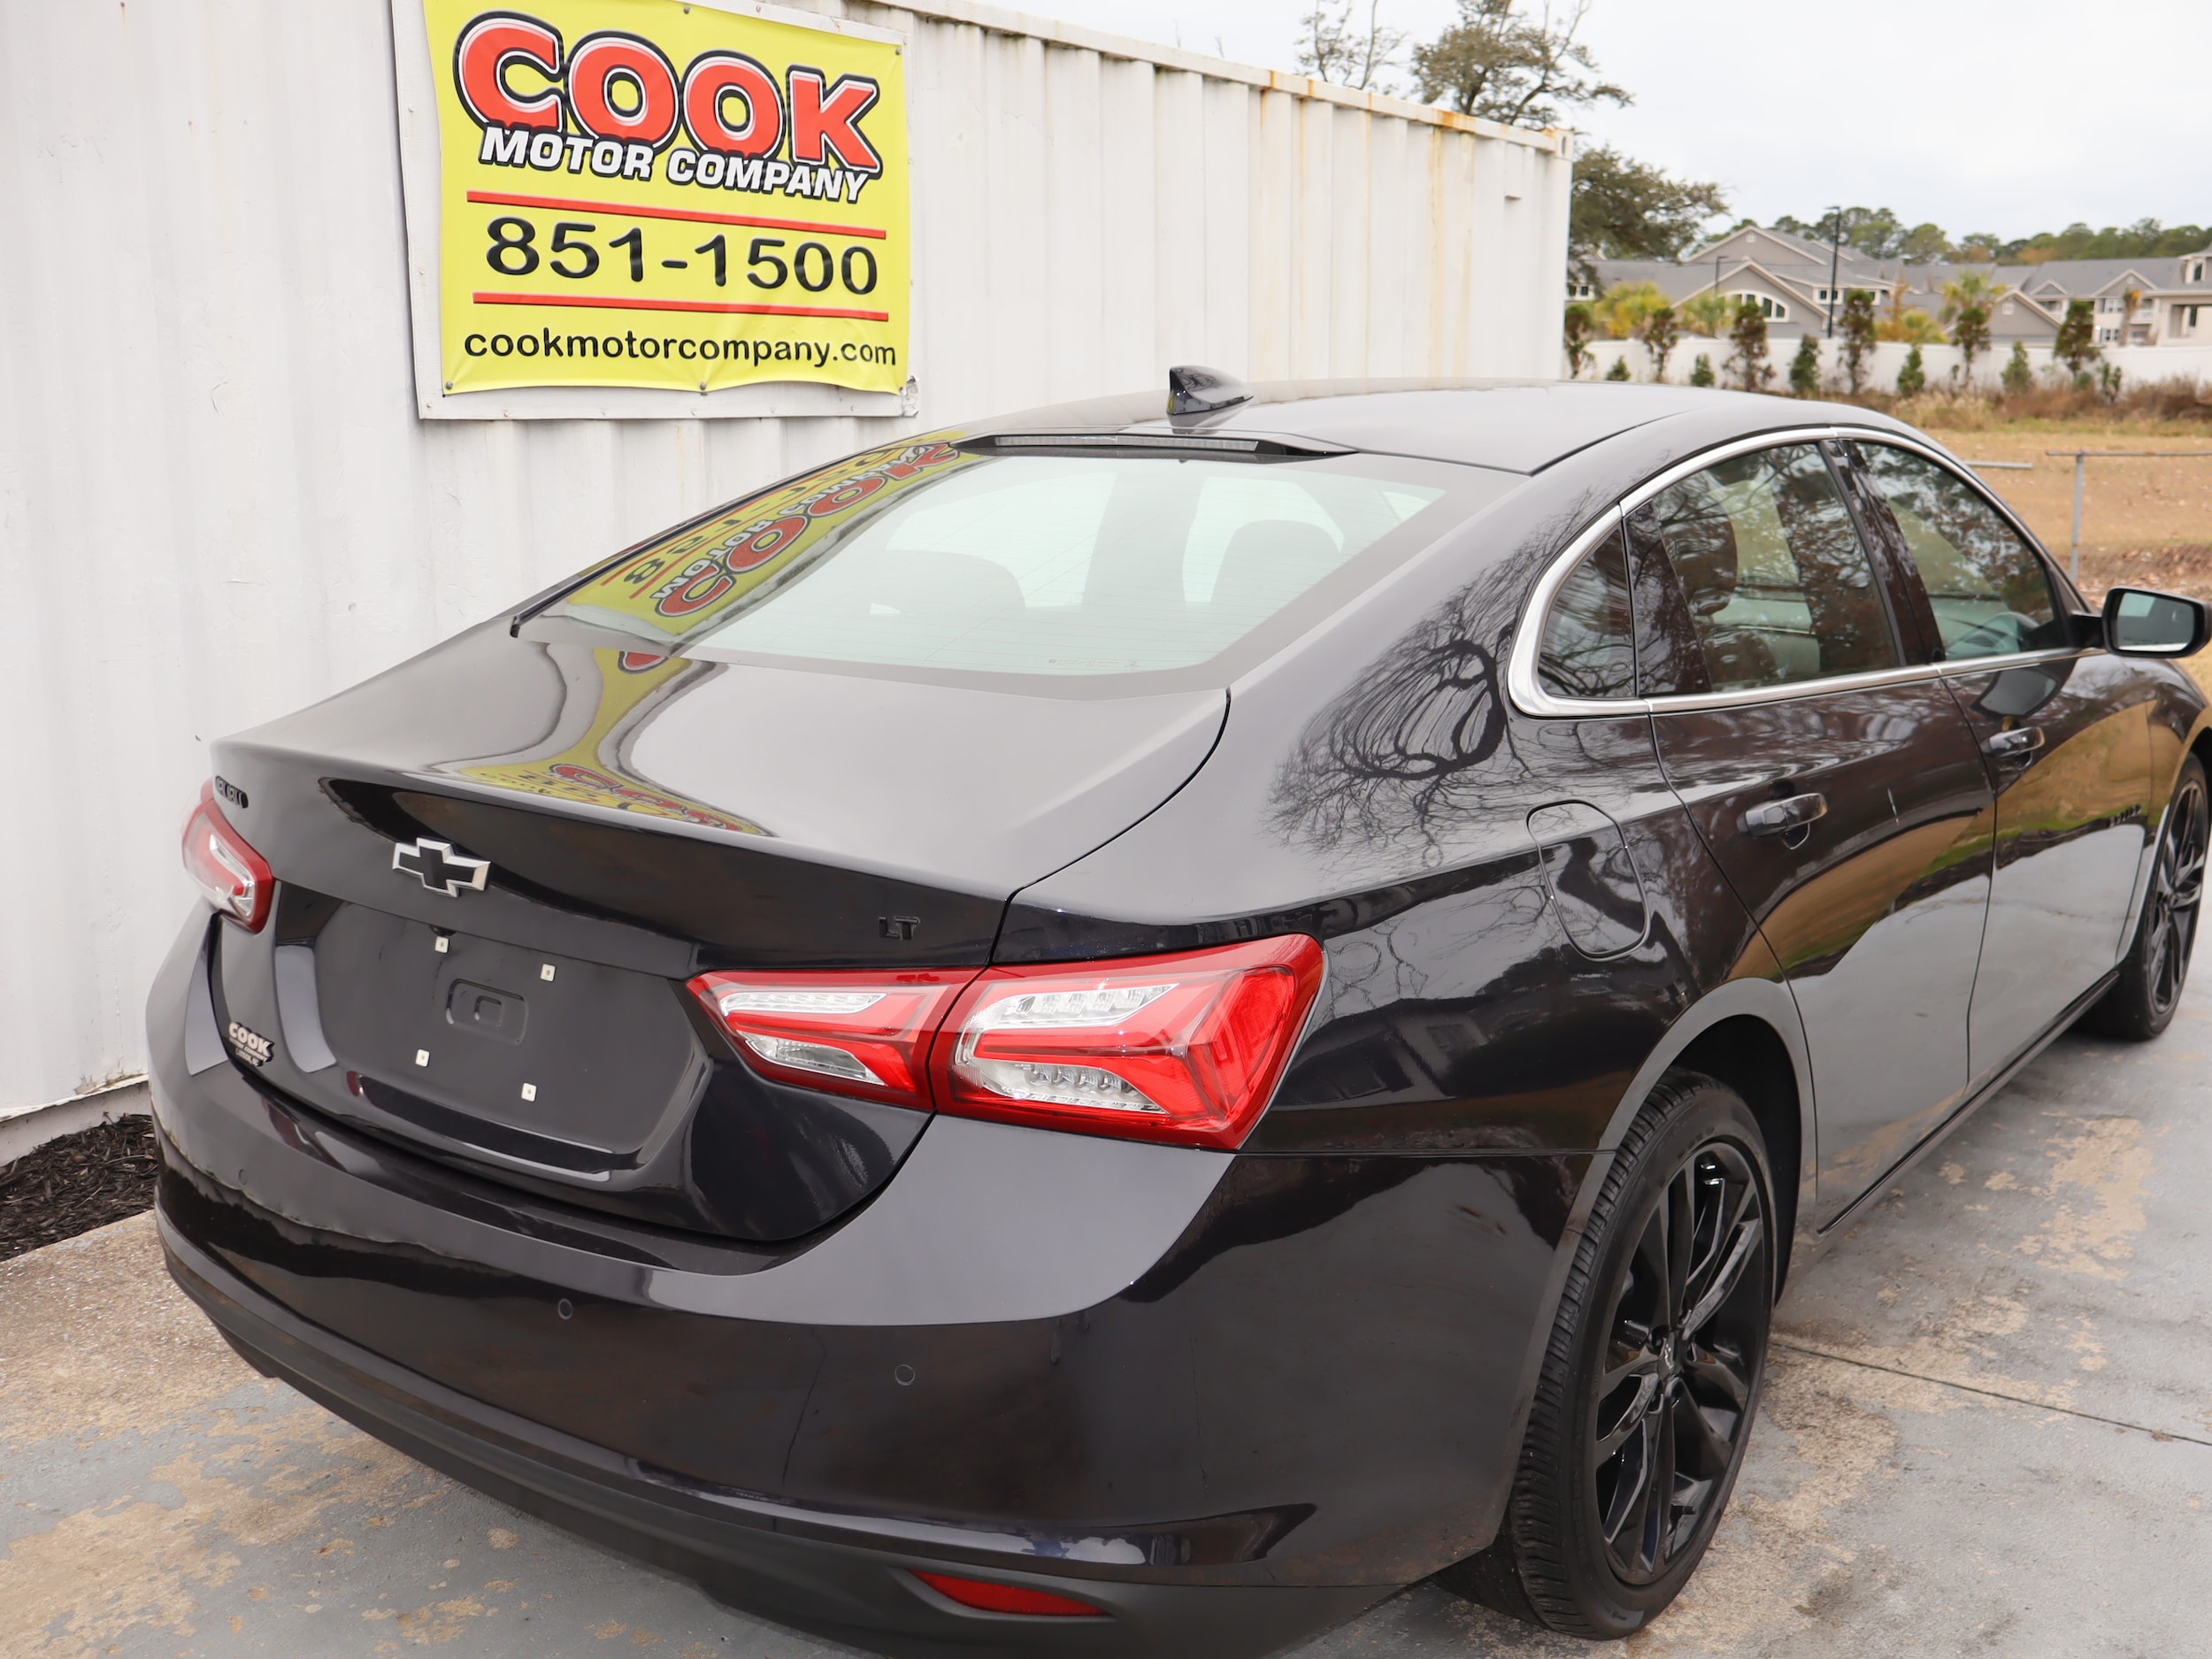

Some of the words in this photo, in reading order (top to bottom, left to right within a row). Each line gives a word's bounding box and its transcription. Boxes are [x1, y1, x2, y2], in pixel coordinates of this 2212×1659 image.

[454, 12, 881, 177] COOK
[479, 126, 657, 181] MOTOR
[666, 149, 870, 204] COMPANY
[486, 216, 878, 295] 851-1500
[464, 327, 896, 368] cookmotorcompany.com
[878, 916, 920, 941] LT
[228, 1021, 273, 1057] COOK
